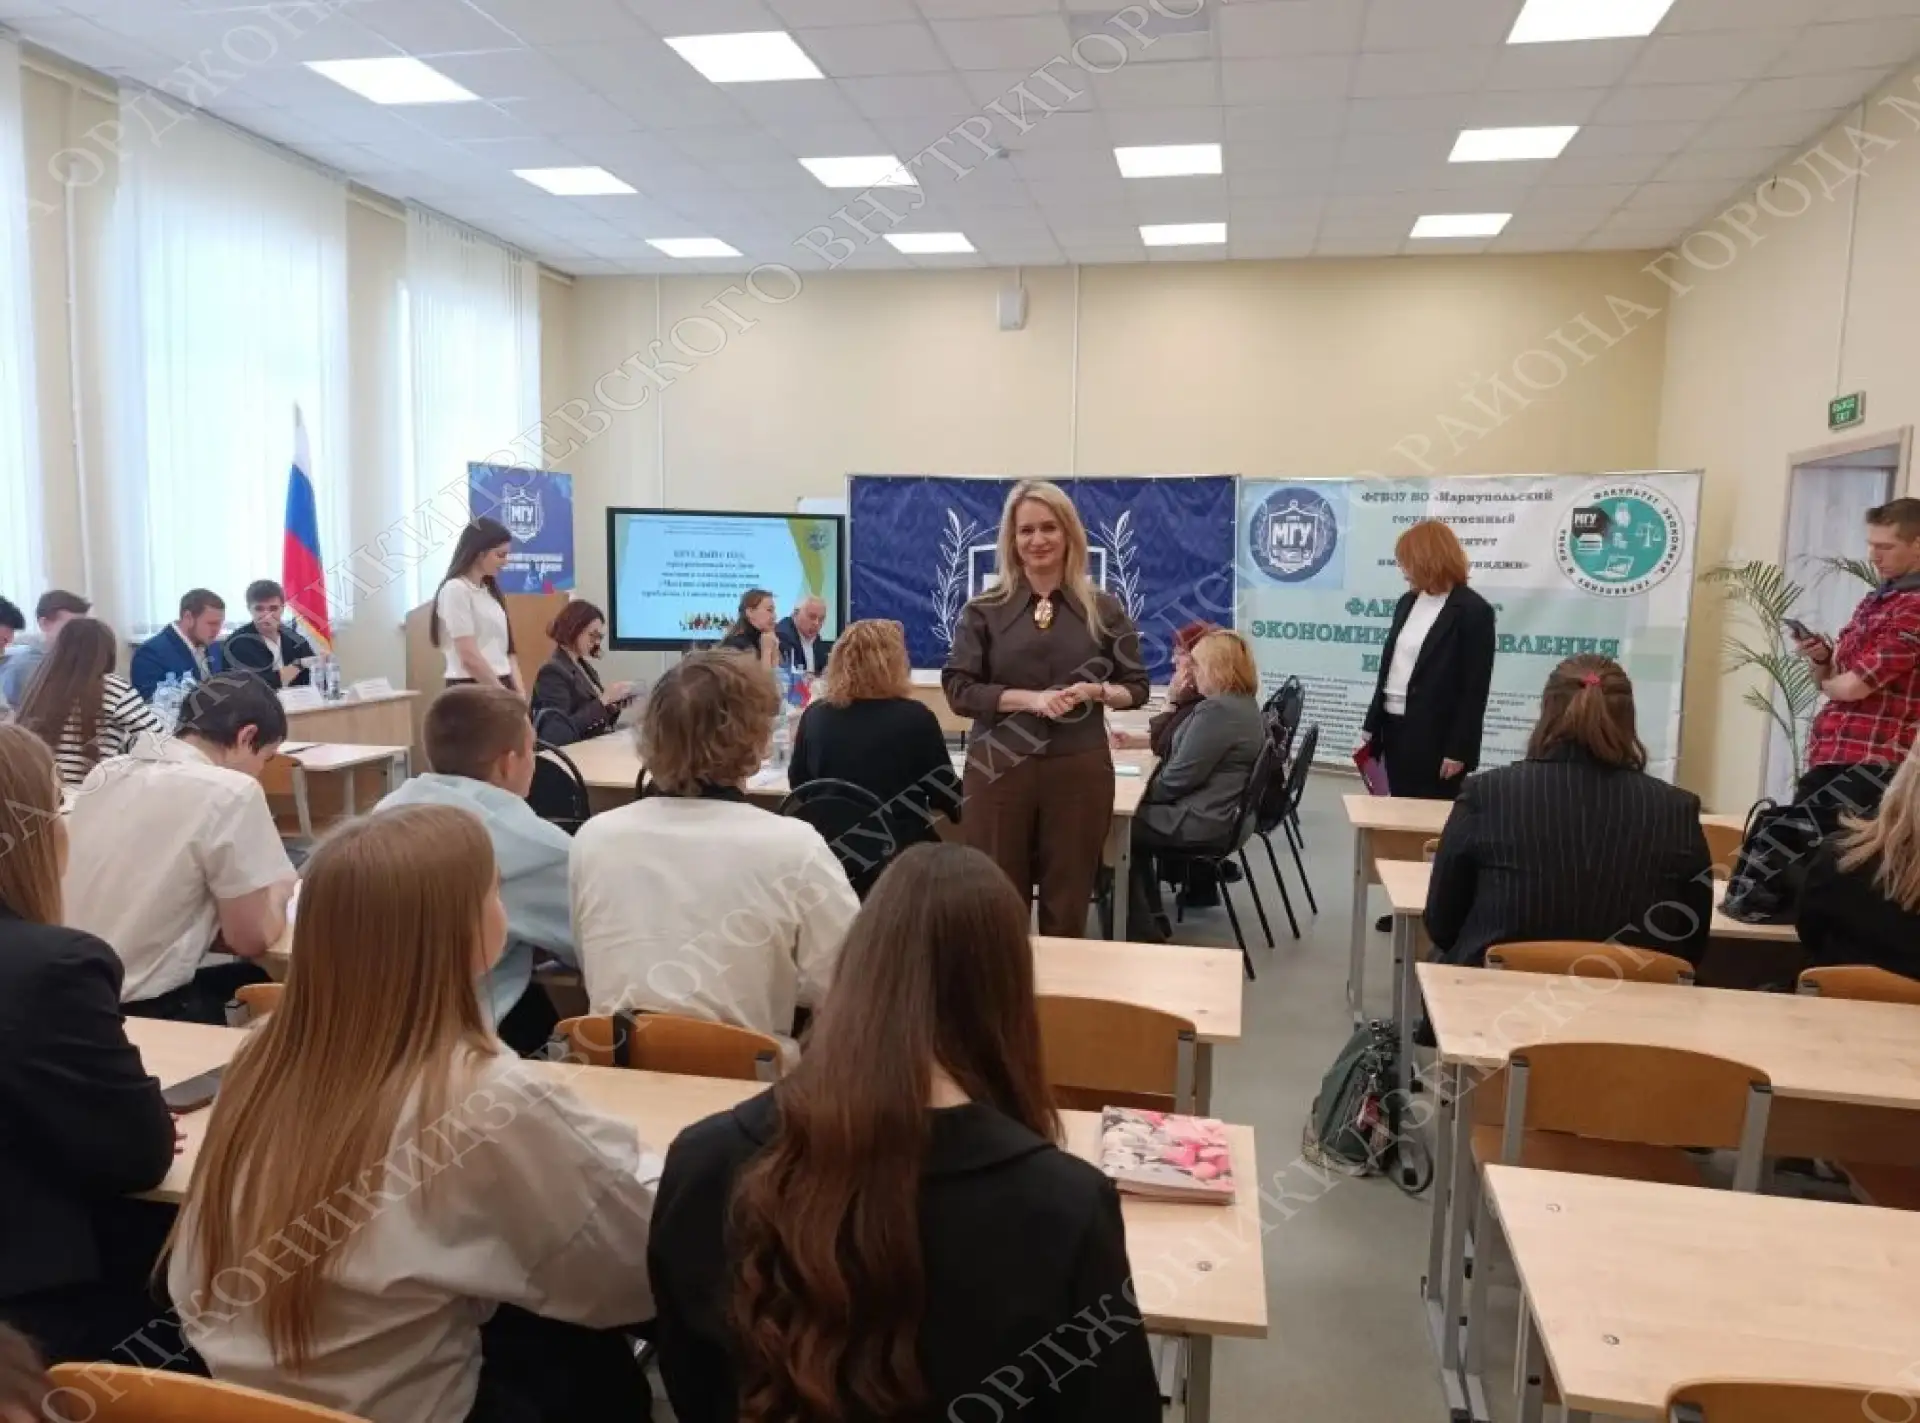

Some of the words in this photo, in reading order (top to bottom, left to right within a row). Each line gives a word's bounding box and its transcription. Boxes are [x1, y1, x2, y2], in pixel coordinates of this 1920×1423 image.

[511, 504, 534, 523] МГУ
[1574, 513, 1597, 526] МГУ
[1272, 521, 1312, 547] МГУ
[1252, 620, 1392, 646] ЭКОНОМИК
[1496, 633, 1619, 659] ВЛЕНИЯ
